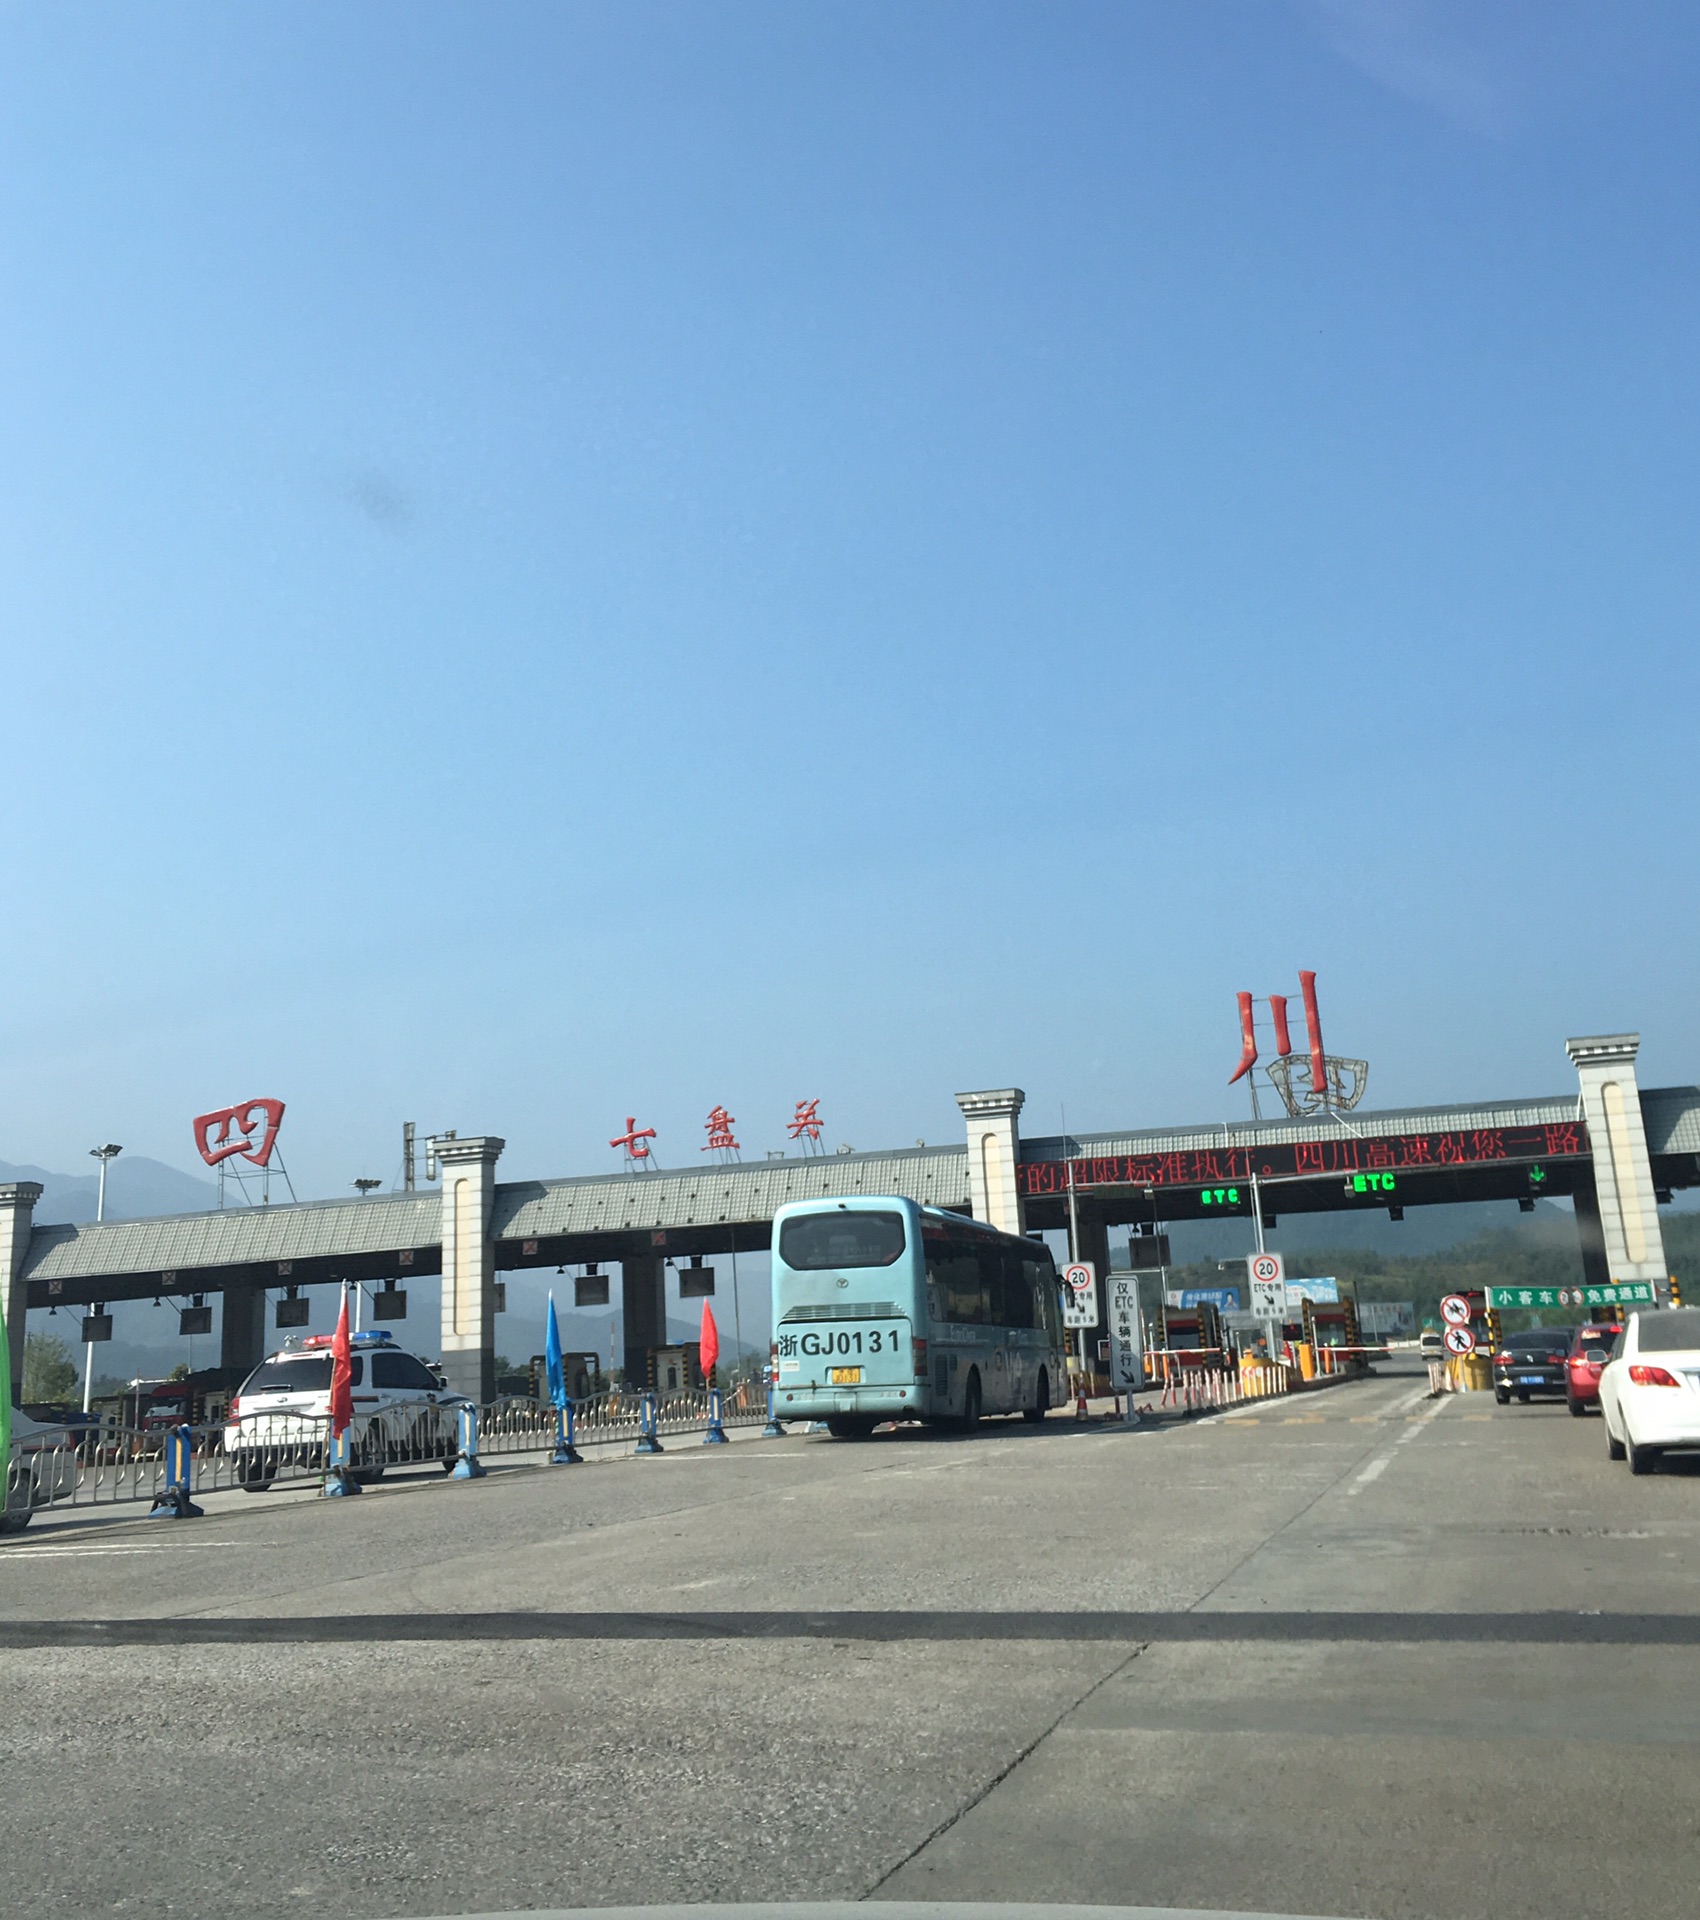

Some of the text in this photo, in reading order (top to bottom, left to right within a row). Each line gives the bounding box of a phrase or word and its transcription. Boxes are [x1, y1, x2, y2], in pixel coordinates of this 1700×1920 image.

[1228, 970, 1327, 1094] 川
[194, 1098, 284, 1166] 四
[609, 1098, 823, 1158] 七盘关
[1353, 1173, 1396, 1192] ETC
[1202, 1188, 1239, 1205] ETC
[1072, 1272, 1086, 1284] 20
[1259, 1263, 1274, 1275] 20
[1499, 1290, 1553, 1305] 小客车
[1587, 1286, 1649, 1303] 免费通道
[778, 1330, 899, 1357] 浙GJ0131
